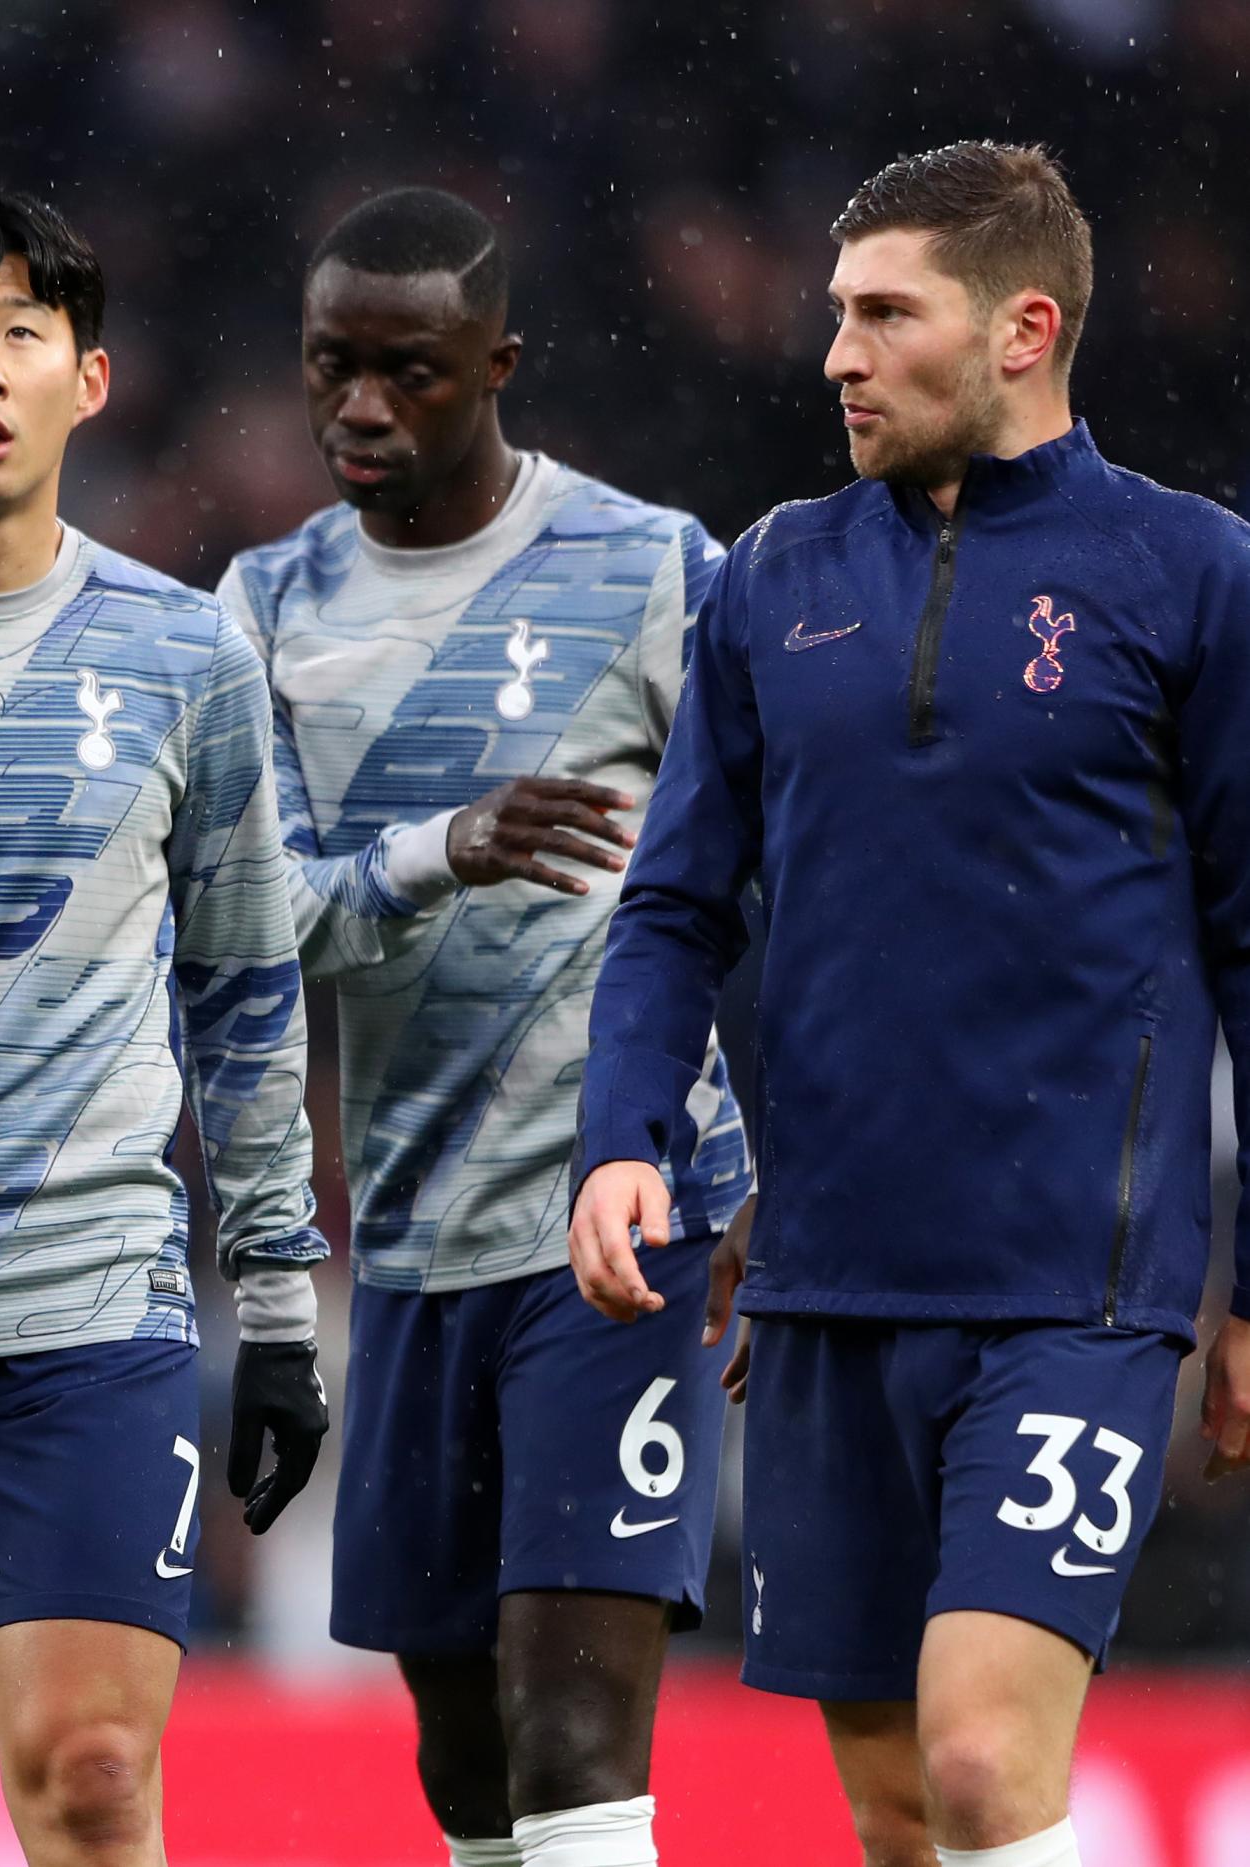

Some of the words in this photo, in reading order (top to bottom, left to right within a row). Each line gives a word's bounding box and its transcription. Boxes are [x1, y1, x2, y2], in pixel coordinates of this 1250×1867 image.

[172, 1434, 200, 1555] 7
[619, 1377, 684, 1498] 6
[996, 1412, 1144, 1555] 33
